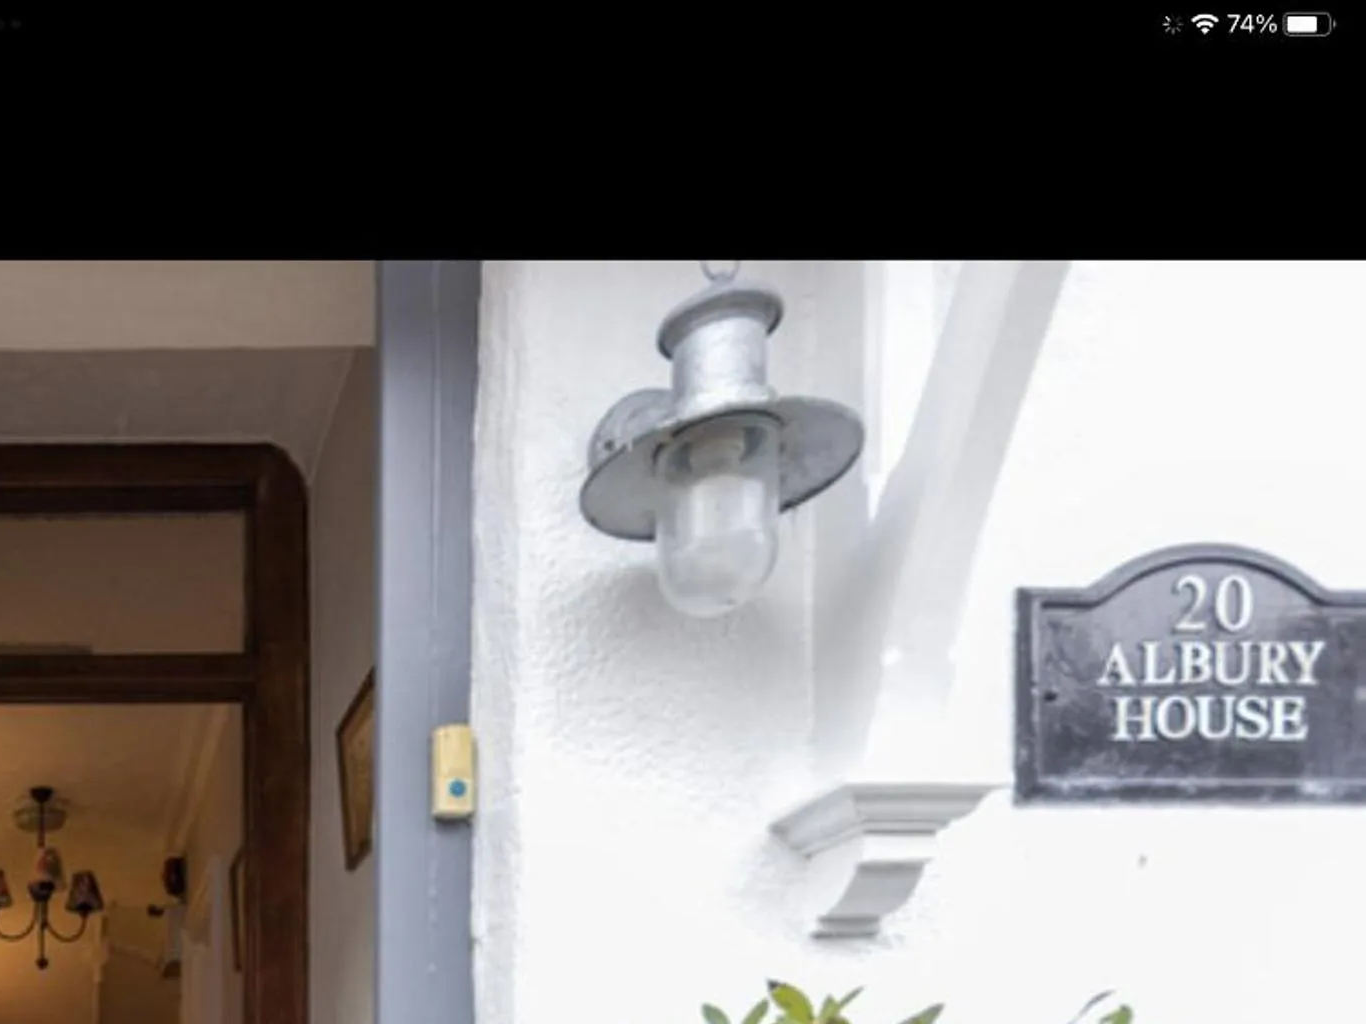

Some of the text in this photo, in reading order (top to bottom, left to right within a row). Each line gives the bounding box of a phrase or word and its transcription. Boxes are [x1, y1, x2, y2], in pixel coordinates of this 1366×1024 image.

[1173, 574, 1254, 633] 20
[1096, 640, 1326, 687] ALBURY
[1112, 693, 1309, 742] HOUSE
